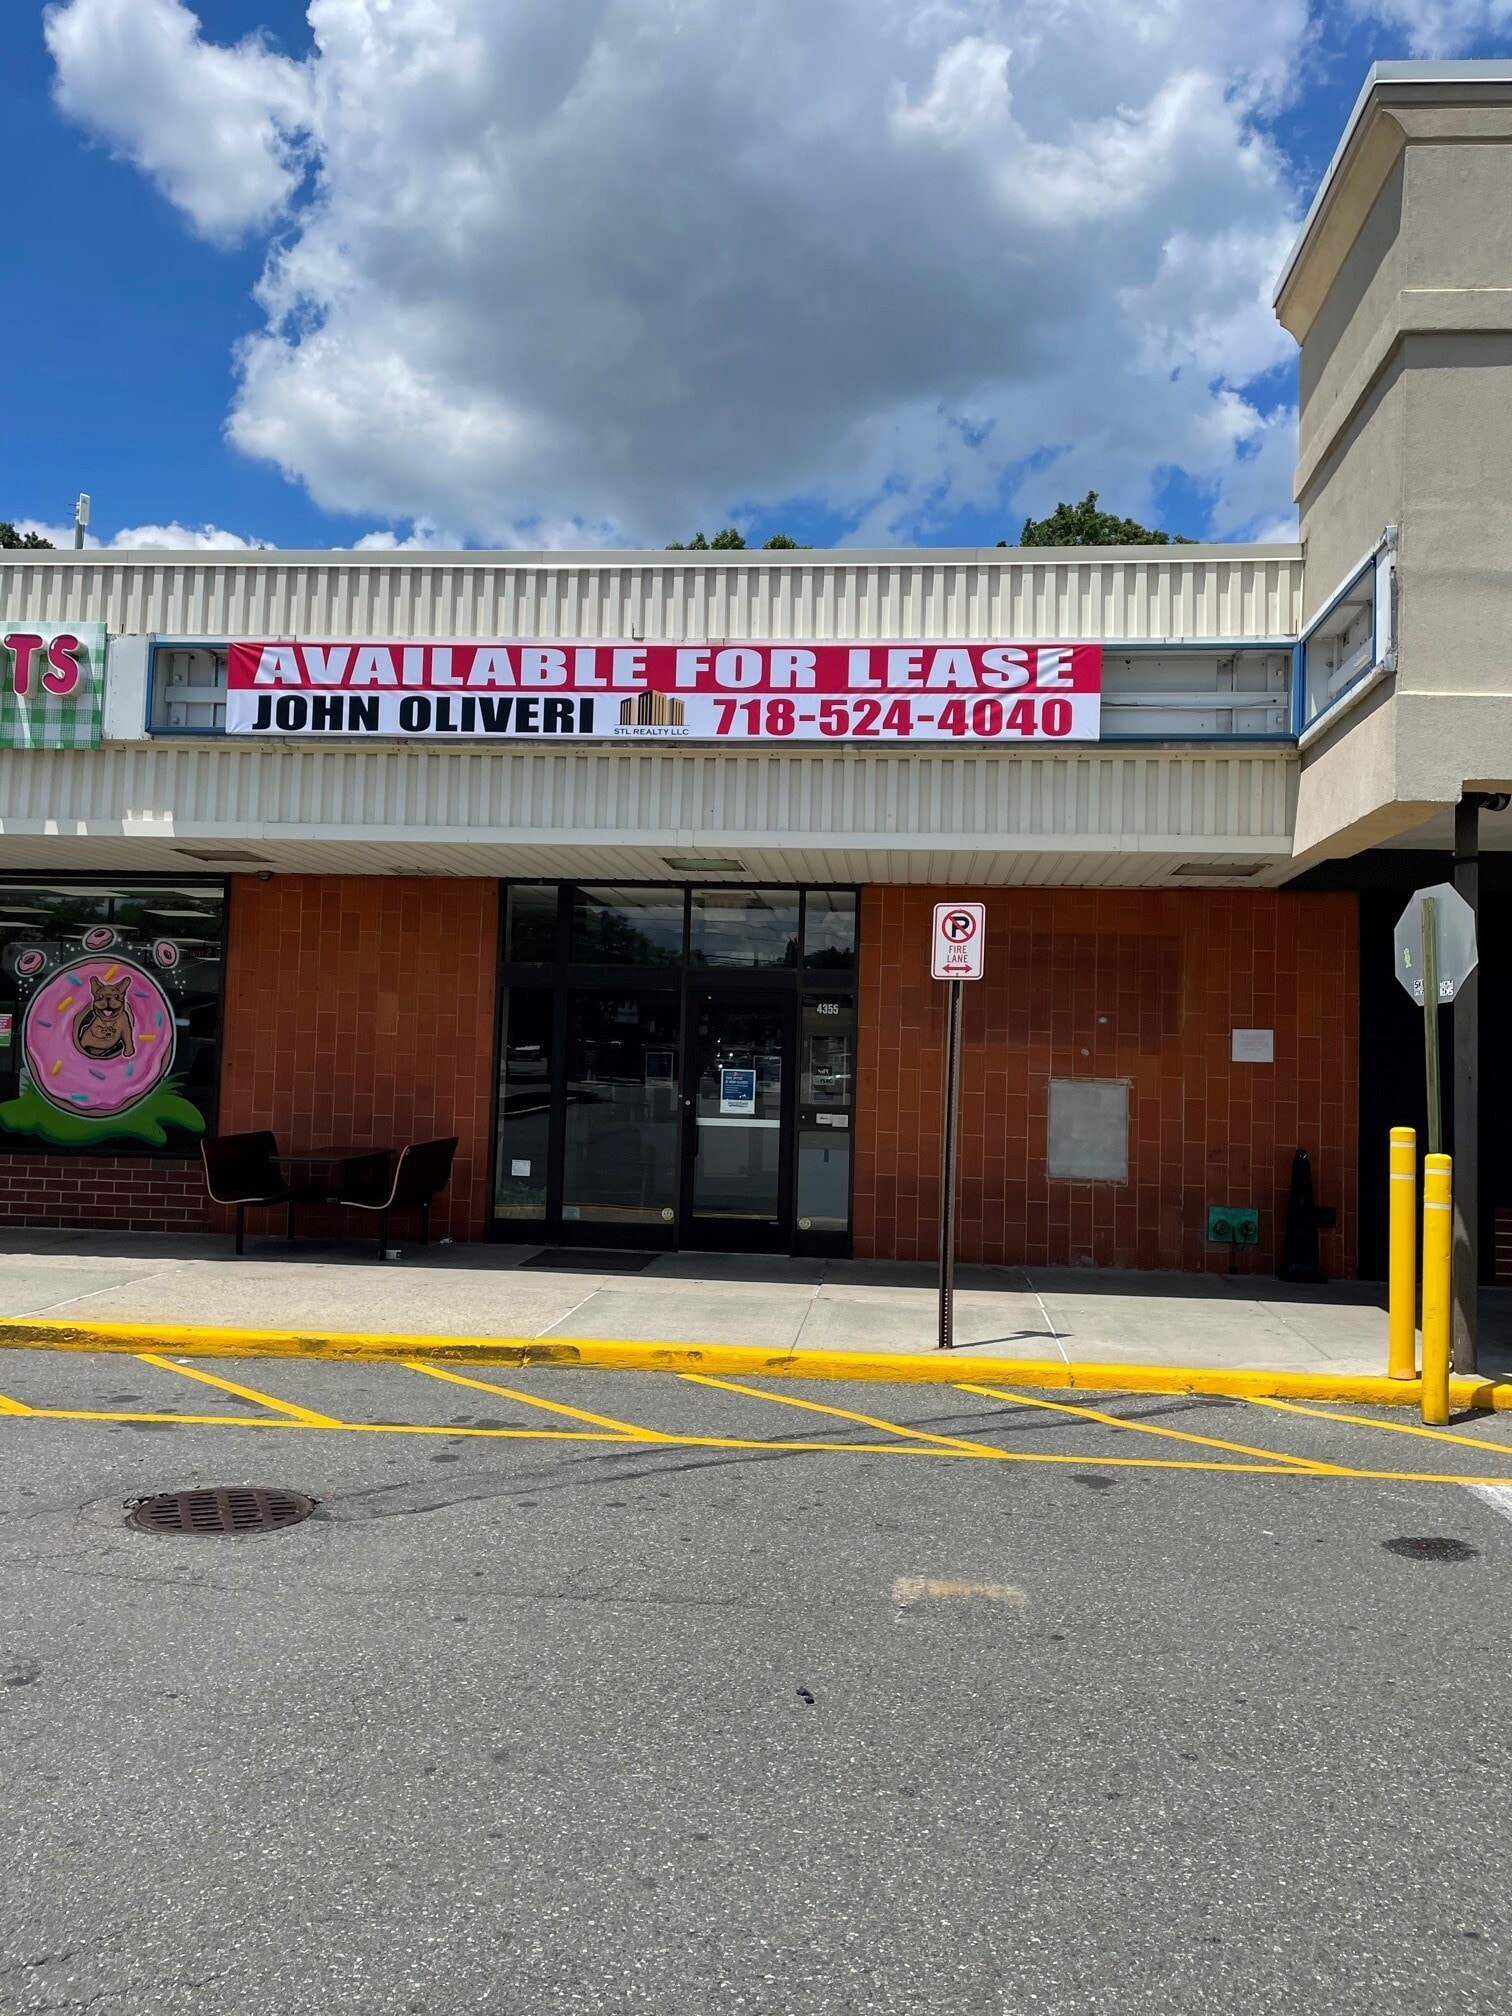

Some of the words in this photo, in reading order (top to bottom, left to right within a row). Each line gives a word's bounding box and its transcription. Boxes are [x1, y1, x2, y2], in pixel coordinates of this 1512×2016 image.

[253, 646, 648, 687] AVAILABLE
[676, 648, 816, 688] FOR
[848, 648, 1075, 688] LEASE
[252, 695, 379, 731] JOHN
[398, 695, 594, 734] OLIVERI
[714, 698, 1073, 737] 718-524-4040
[947, 954, 968, 963] LANE
[948, 945, 967, 954] FIRE
[816, 1003, 839, 1015] 4355
